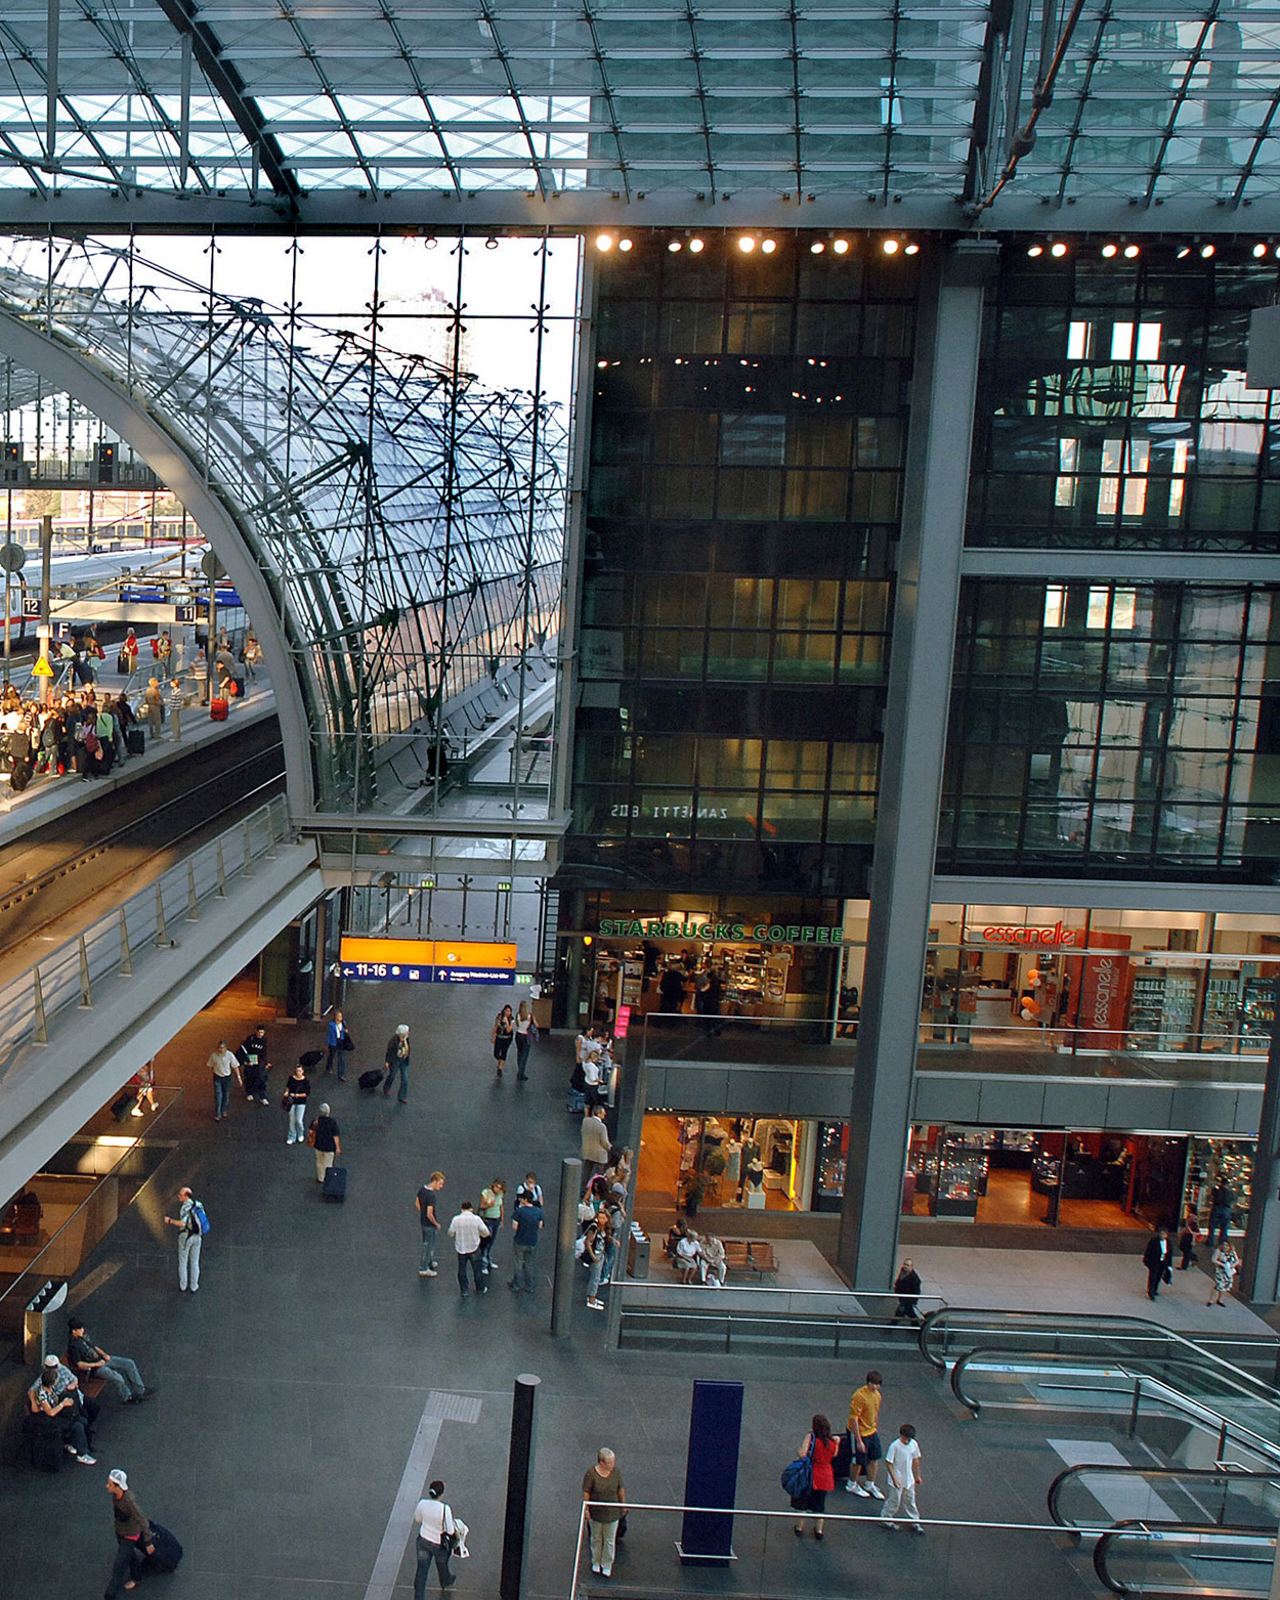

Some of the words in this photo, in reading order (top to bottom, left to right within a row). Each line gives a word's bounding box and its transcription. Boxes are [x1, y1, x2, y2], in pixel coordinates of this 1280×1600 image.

[25, 600, 39, 612] 12
[182, 606, 194, 620] 11
[58, 623, 70, 638] F
[599, 919, 746, 940] STARBUCKS
[753, 924, 844, 944] COFFEE
[983, 920, 1076, 945] essanelle
[356, 964, 387, 977] 11-16
[1092, 958, 1113, 1024] essanelle
